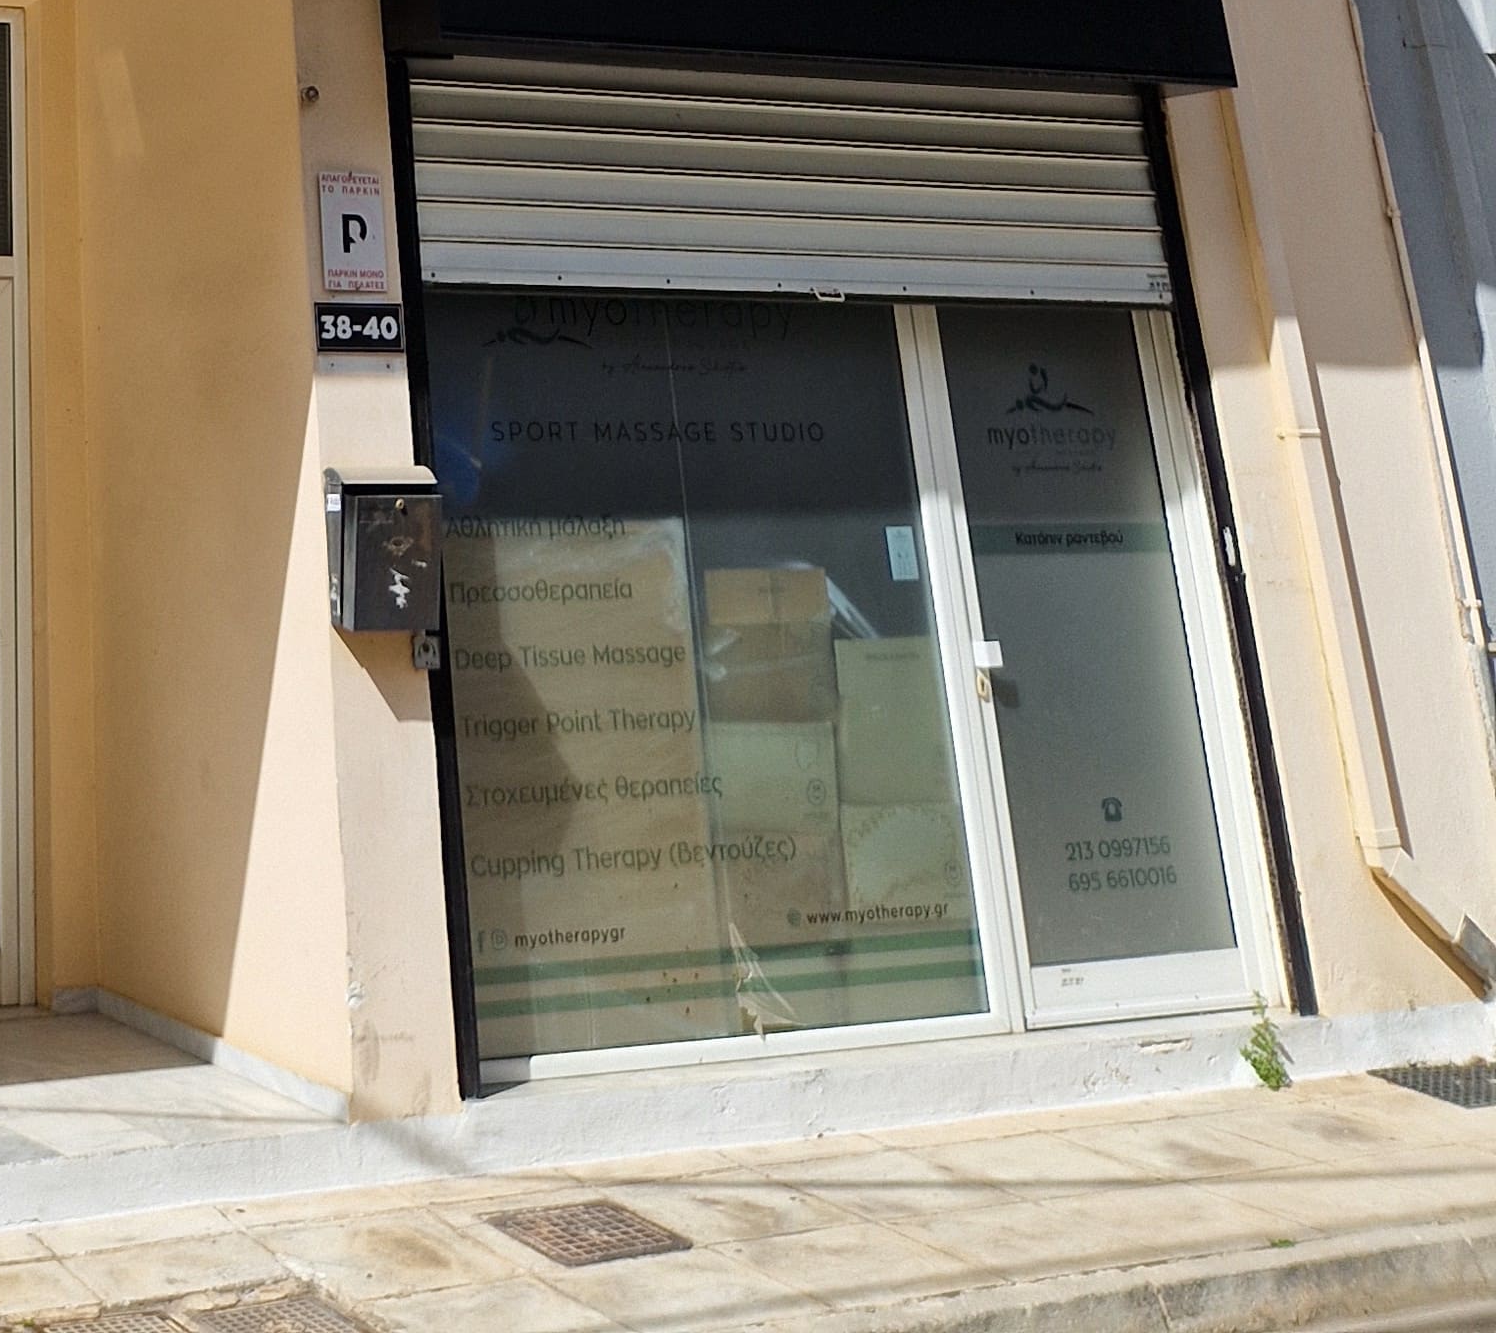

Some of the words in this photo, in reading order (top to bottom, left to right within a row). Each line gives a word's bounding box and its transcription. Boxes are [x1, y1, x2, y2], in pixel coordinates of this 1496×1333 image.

[321, 173, 380, 184] ΑΠΑΓΟΡΕΥΕΤΑΙ
[321, 184, 335, 193] ΤΟ
[342, 185, 380, 195] ΠΑΡΚΙΝ
[328, 268, 358, 278] ΠΑΡΚΙΝ
[359, 269, 384, 279] ΜΟΝΟ
[328, 279, 342, 288] ΓΙΑ
[348, 280, 384, 290] ΠΕΛΑΤΕΣ
[320, 314, 398, 341] 38-40
[491, 420, 578, 443] SPORT
[595, 421, 717, 443] MASSAGE
[731, 420, 824, 443] STUDIO
[446, 513, 541, 539] Αθλητική
[548, 515, 626, 540] μάλαξη
[449, 577, 633, 607] Πρεσσοθεραπεία
[455, 648, 512, 672] Deep
[519, 645, 586, 667] Tissue
[593, 643, 687, 669] Massage
[462, 715, 539, 742] Trigger
[546, 709, 602, 735] Point
[609, 708, 697, 734] Therapy
[464, 777, 608, 805] Στοχευμένες
[615, 771, 723, 801] θεραπείες
[470, 852, 565, 880] Cupping
[574, 843, 662, 872] Therapy
[1065, 840, 1094, 862] 213
[1098, 835, 1172, 859] 0997156
[1068, 870, 1102, 892] 695
[1106, 864, 1178, 889] 6610016
[806, 903, 949, 924] www.myotherapy.gr
[514, 927, 626, 949] myotherapygr
